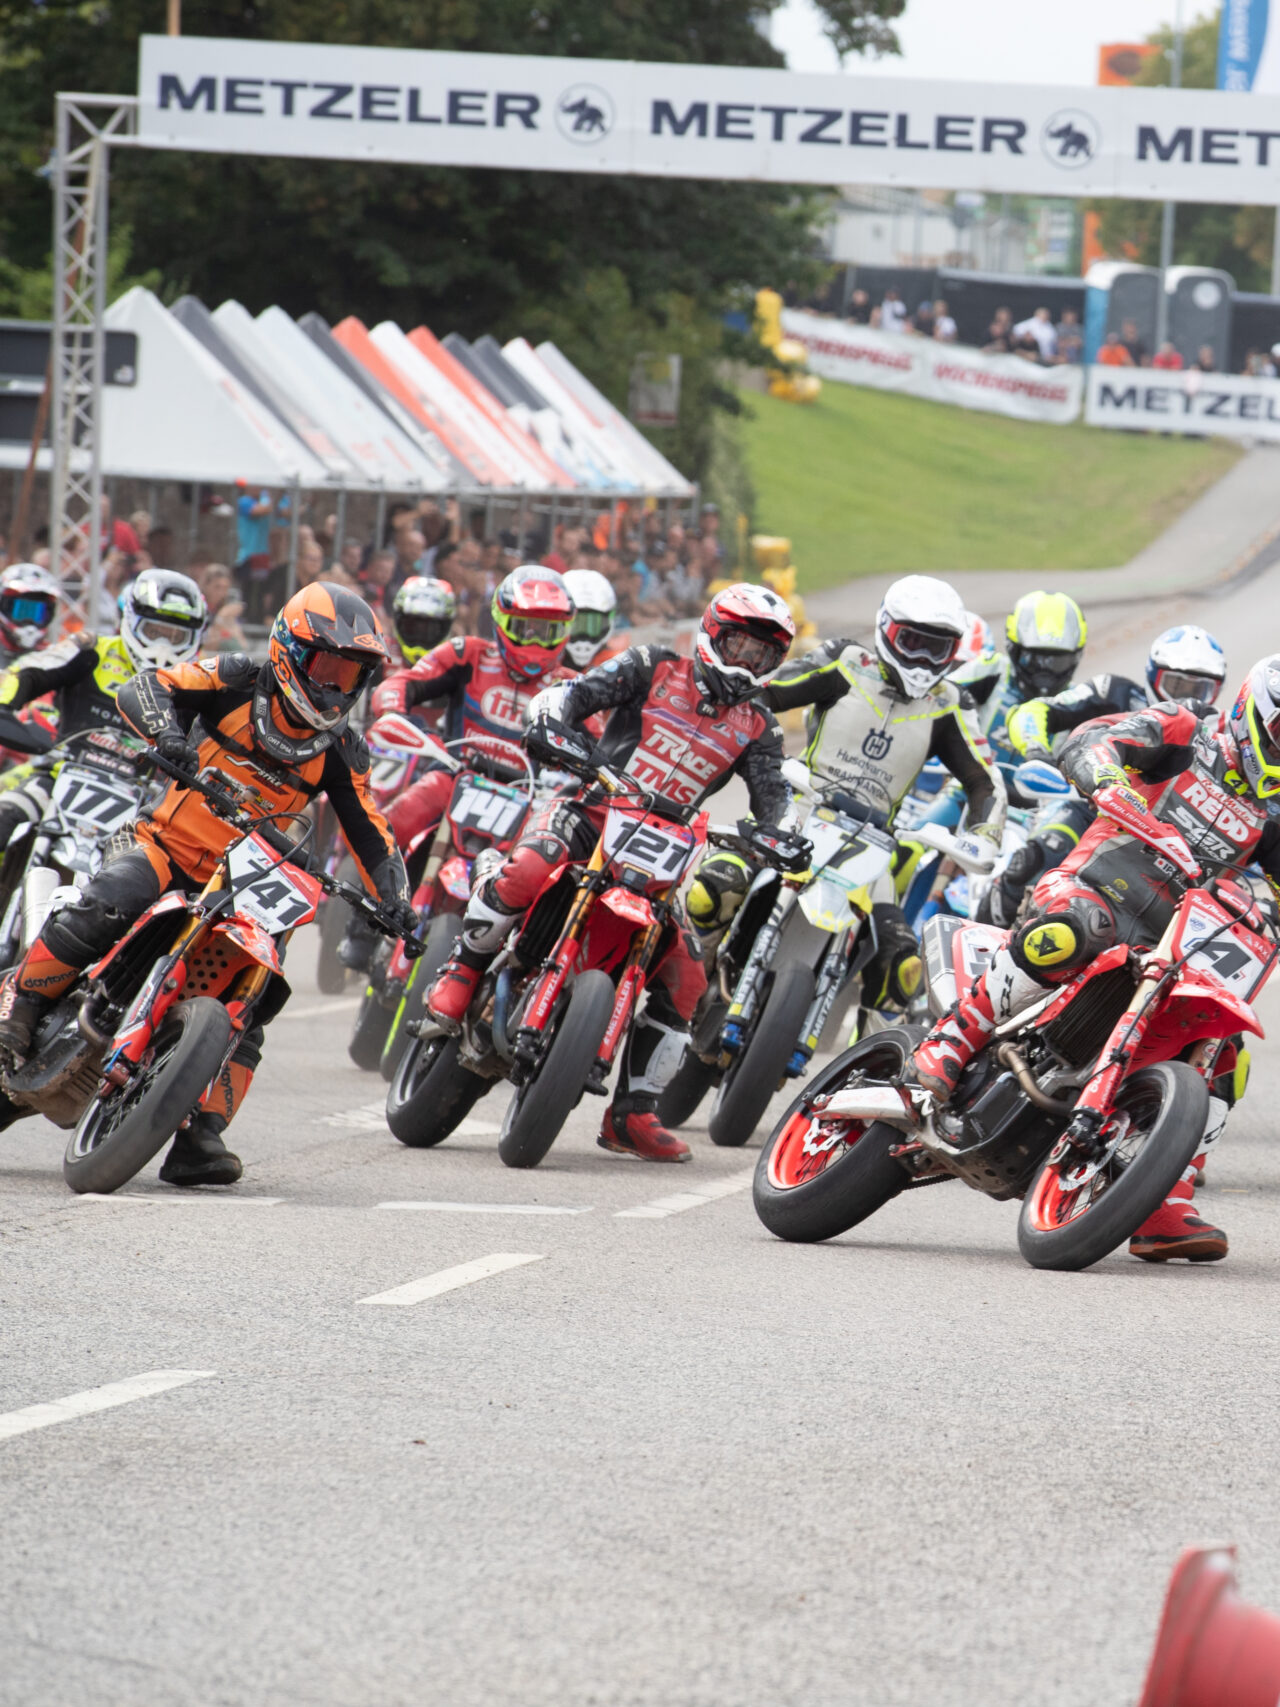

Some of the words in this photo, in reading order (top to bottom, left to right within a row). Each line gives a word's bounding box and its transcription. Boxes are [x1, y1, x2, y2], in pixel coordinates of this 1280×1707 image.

[159, 74, 541, 130] METZELER
[651, 101, 1027, 155] METZELER
[631, 756, 697, 805] TMS
[836, 748, 898, 784] Husqvarna
[59, 779, 137, 825] 177
[450, 786, 522, 837] 141
[1108, 801, 1156, 835] POLISPORT
[1181, 782, 1249, 843] REDD
[612, 821, 689, 873] 121
[826, 833, 869, 869] 7
[231, 858, 312, 926] 741
[24, 968, 78, 988] daytona
[1194, 937, 1253, 979] 4
[607, 980, 642, 1037] METZELER
